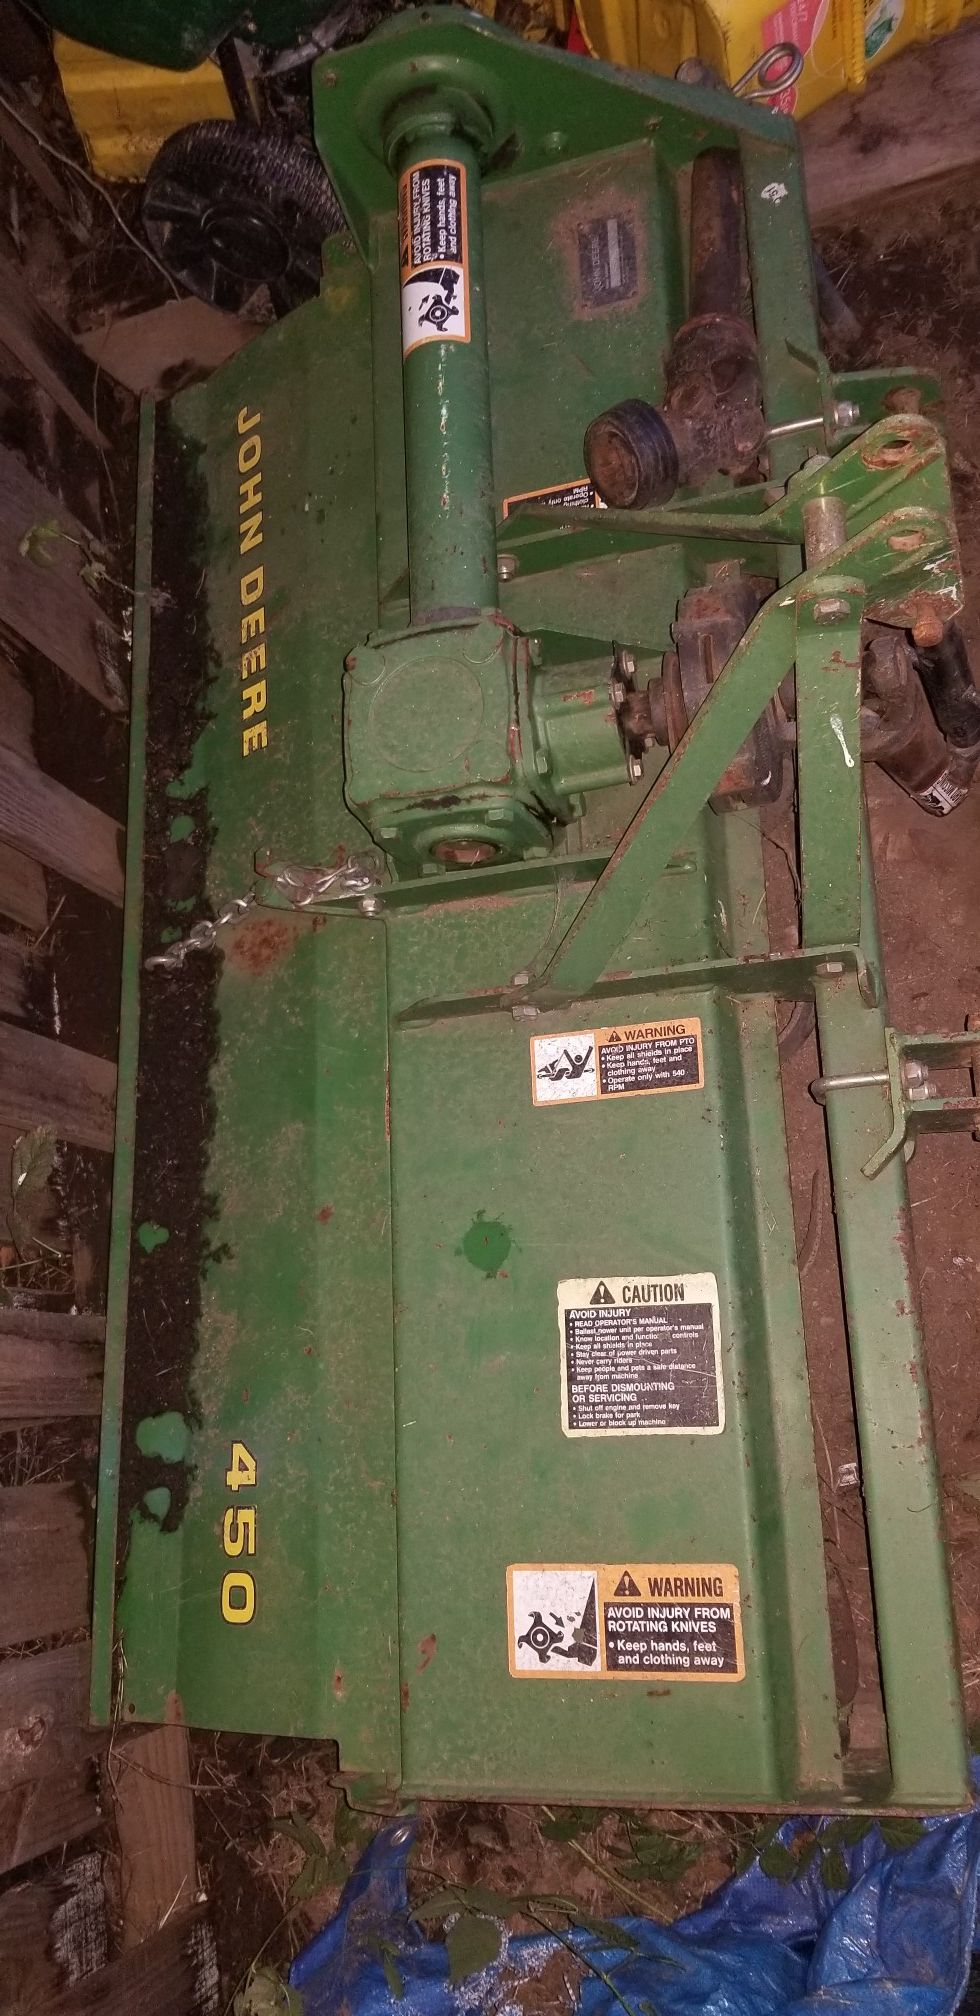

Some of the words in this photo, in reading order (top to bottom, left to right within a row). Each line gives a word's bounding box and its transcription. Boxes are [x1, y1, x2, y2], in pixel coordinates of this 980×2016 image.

[412, 171, 420, 198] FROM
[437, 178, 445, 196] feet
[449, 174, 457, 198] away
[421, 179, 431, 214] KNIVES
[413, 203, 421, 235] INJURY
[448, 199, 457, 234] clothing
[422, 215, 431, 261] ROTATING
[438, 229, 447, 253] Keep
[449, 236, 457, 254] and
[412, 235, 421, 264] AVOID
[237, 406, 263, 555] JOHN
[240, 565, 268, 758] DEERE
[624, 1025, 686, 1040] WARNING
[601, 1045, 623, 1054] AVOID
[626, 1043, 652, 1052] INJURY
[655, 1040, 677, 1048] FROM
[679, 1038, 695, 1046] PTO
[606, 1054, 624, 1062] Keep
[637, 1049, 662, 1058] shields
[674, 1046, 693, 1055] place
[607, 1062, 625, 1070] Keep
[653, 1056, 667, 1064] feet
[608, 1068, 635, 1077] clothing
[638, 1066, 656, 1074] away
[608, 1076, 636, 1085] Operate
[638, 1073, 653, 1082] only
[655, 1071, 670, 1079] with
[672, 1069, 685, 1077] 540
[608, 1083, 625, 1091] RPM
[622, 1283, 685, 1303] CAUTION
[569, 1310, 597, 1319] AVOID
[599, 1308, 631, 1317] INJURY
[575, 1320, 593, 1328] READ
[639, 1316, 667, 1324] MANUAL
[603, 1341, 625, 1349] shields
[576, 1351, 590, 1359] Stay
[661, 1347, 677, 1355] parts
[596, 1358, 612, 1366] carry
[577, 1366, 592, 1374] Keep
[594, 1366, 615, 1374] people
[595, 1373, 609, 1381] from
[572, 1384, 608, 1393] BEFORE
[612, 1382, 675, 1392] DISMOUNTING
[572, 1395, 585, 1403] OR
[589, 1393, 637, 1402] SERVICING
[605, 1404, 626, 1412] engine
[669, 1402, 680, 1410] key
[626, 1411, 640, 1419] park
[221, 1440, 257, 1625] 450
[647, 1576, 724, 1598] WARNING
[607, 1607, 644, 1619] AVOID
[648, 1607, 690, 1619] INJURY
[695, 1608, 730, 1619] FROM
[608, 1621, 668, 1633] ROTATING
[671, 1621, 717, 1633] KNIVES
[617, 1639, 647, 1653] Keep
[651, 1640, 690, 1653] hands,
[693, 1641, 717, 1652] feet
[618, 1653, 639, 1665] and
[643, 1653, 690, 1667] clothing
[694, 1656, 724, 1667] away
